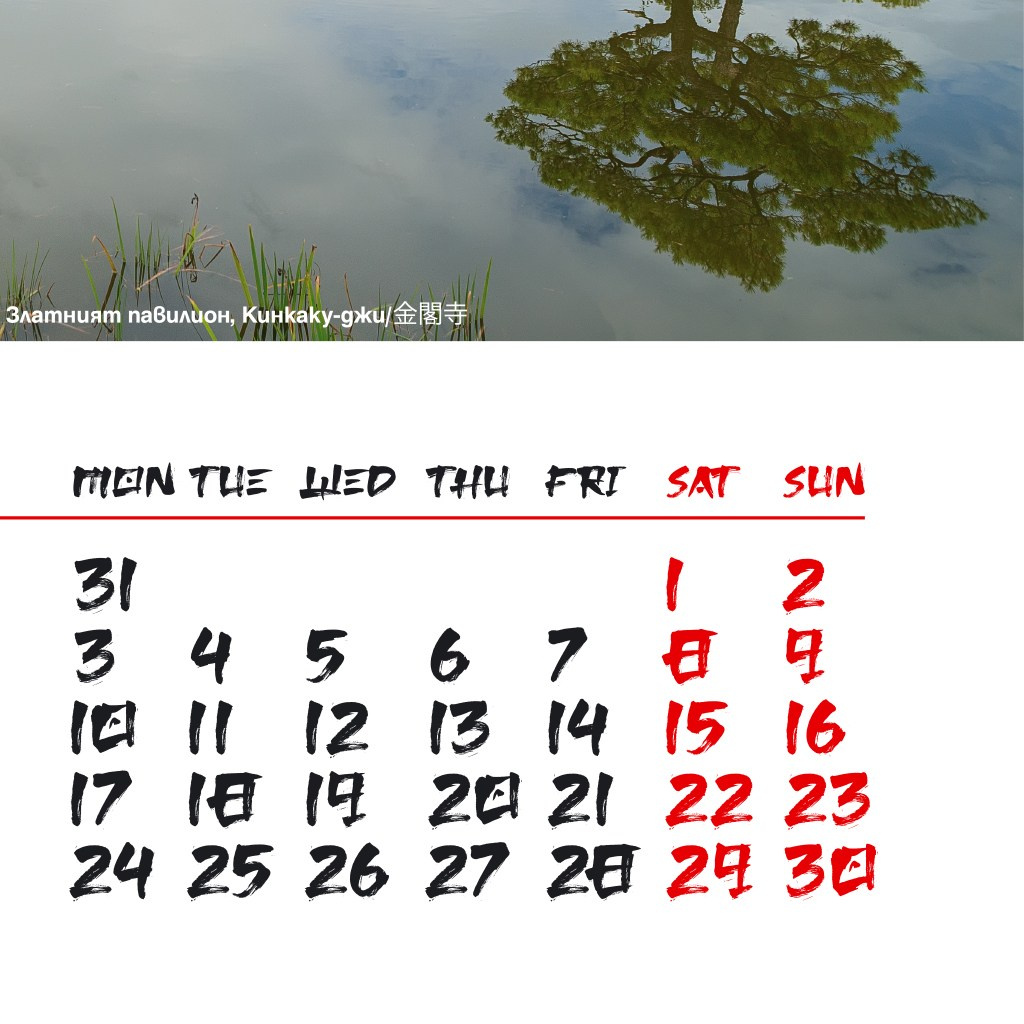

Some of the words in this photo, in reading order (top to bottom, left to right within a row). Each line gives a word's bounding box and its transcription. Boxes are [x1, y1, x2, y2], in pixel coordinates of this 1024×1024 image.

[73, 463, 175, 499] MON
[189, 465, 271, 498] TUE
[299, 464, 396, 499] WED
[426, 465, 509, 499] THU
[545, 465, 626, 499] FRI
[667, 465, 741, 499] SAT
[784, 464, 865, 498] SUN
[74, 557, 137, 612] 31
[666, 557, 684, 611] 1
[782, 558, 825, 615] 2
[75, 629, 114, 684] 3
[191, 627, 232, 684] 4
[306, 629, 347, 683] 5
[430, 628, 470, 682] 6
[548, 627, 587, 682] 7
[662, 629, 717, 685] 8
[786, 628, 824, 685] 9
[71, 700, 138, 755] 10
[189, 700, 233, 755] 11
[306, 701, 368, 758] 12
[430, 700, 489, 756] 13
[548, 699, 608, 756] 14
[666, 701, 728, 755] 15
[786, 699, 846, 755] 16
[71, 770, 132, 826] 17
[189, 772, 262, 828] 18
[306, 771, 366, 828] 19
[428, 772, 522, 830] 20
[548, 772, 613, 829] 21
[665, 773, 753, 830] 22
[784, 772, 870, 830] 23
[69, 842, 154, 901] 24
[187, 844, 274, 901] 25
[305, 843, 389, 901] 26
[425, 842, 510, 901] 27
[547, 844, 640, 901] 28
[666, 843, 752, 901] 29
[784, 844, 878, 899] 30
